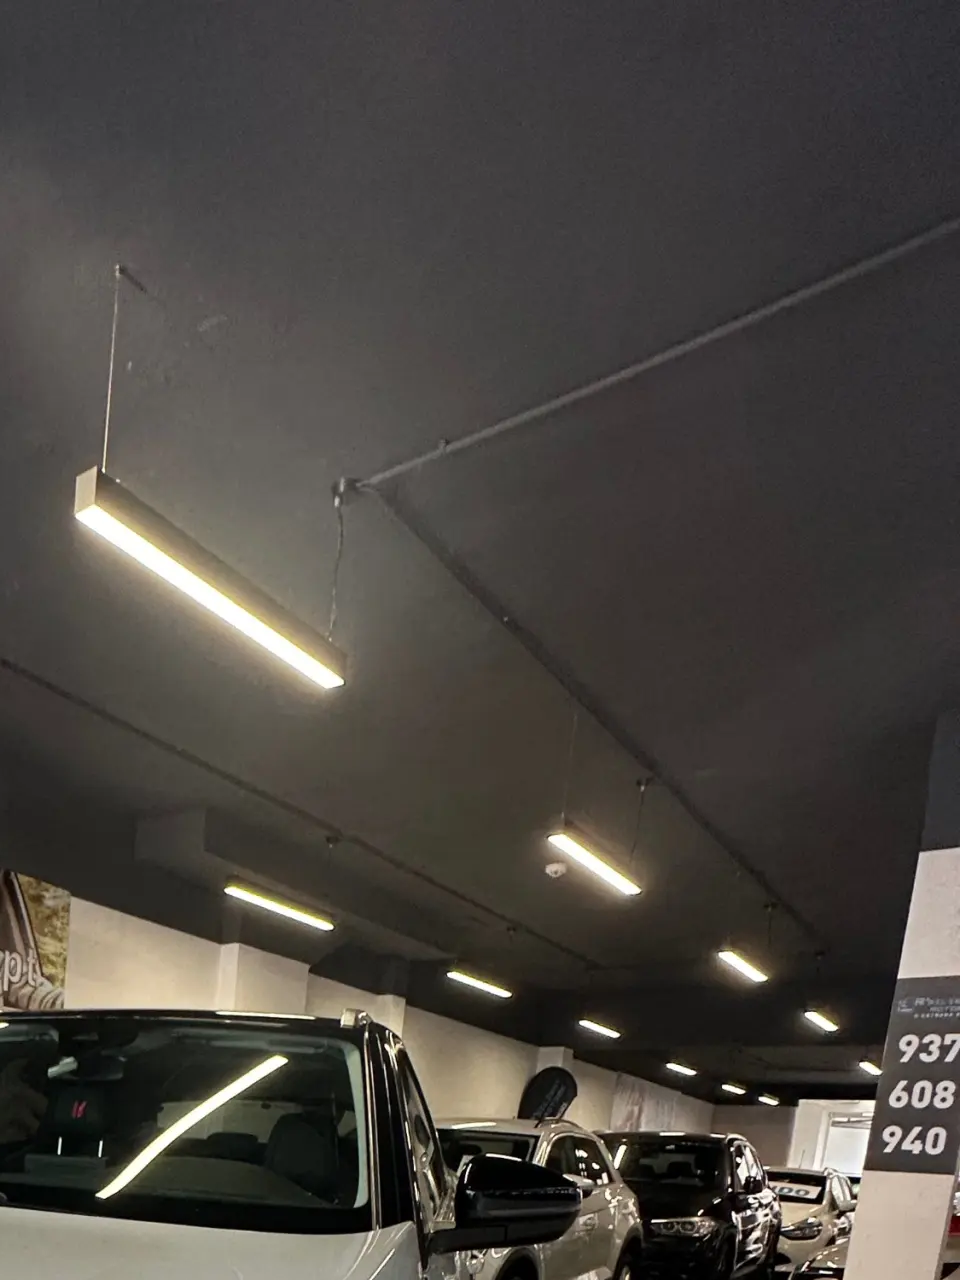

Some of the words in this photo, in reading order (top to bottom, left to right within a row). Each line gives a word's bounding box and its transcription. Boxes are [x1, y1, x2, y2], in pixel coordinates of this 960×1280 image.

[898, 1033, 960, 1063] 937
[889, 1080, 955, 1109] 608
[882, 1125, 947, 1155] 940
